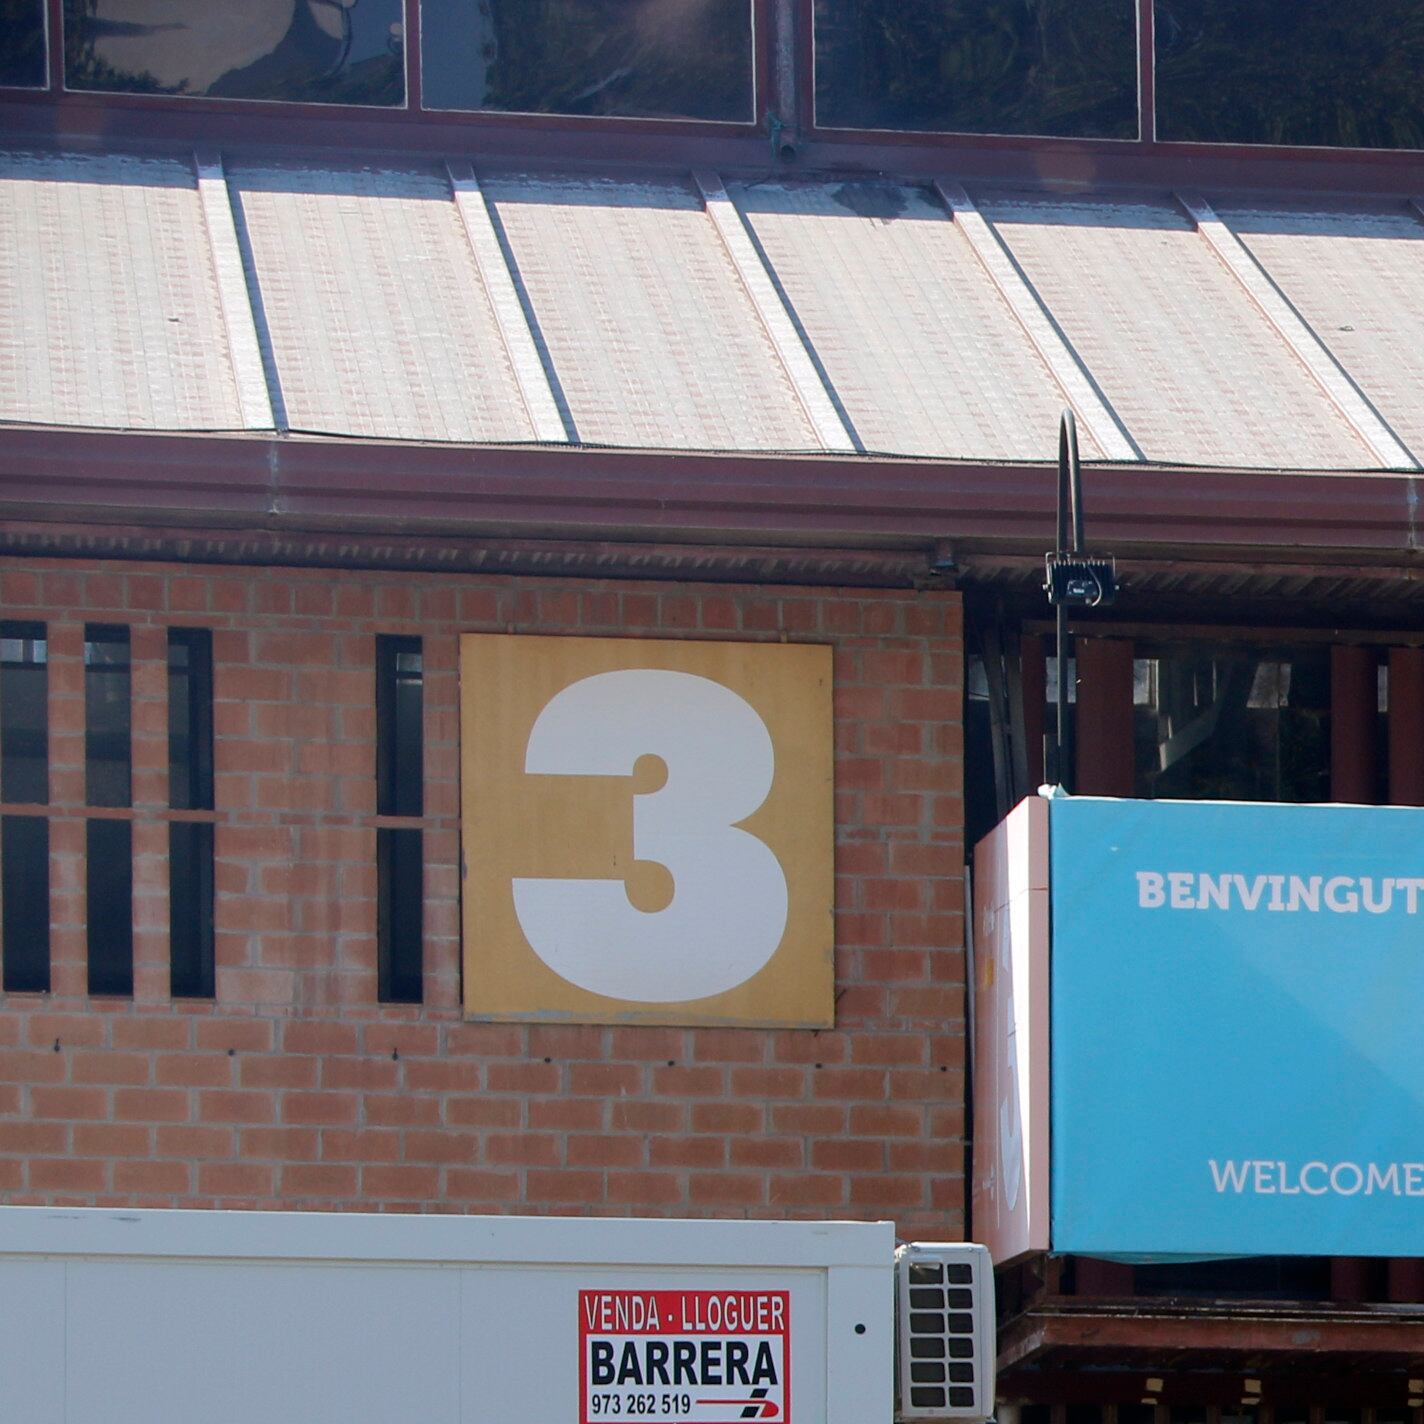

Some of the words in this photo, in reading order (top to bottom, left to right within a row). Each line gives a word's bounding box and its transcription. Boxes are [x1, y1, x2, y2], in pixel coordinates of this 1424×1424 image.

[512, 668, 789, 1003] 3
[584, 1295, 660, 1331] VENDA
[681, 1295, 785, 1331] LLOGUER
[591, 1340, 778, 1386] BARRERA
[592, 1394, 621, 1415] 973
[626, 1394, 656, 1415] 262
[661, 1394, 691, 1415] 519
